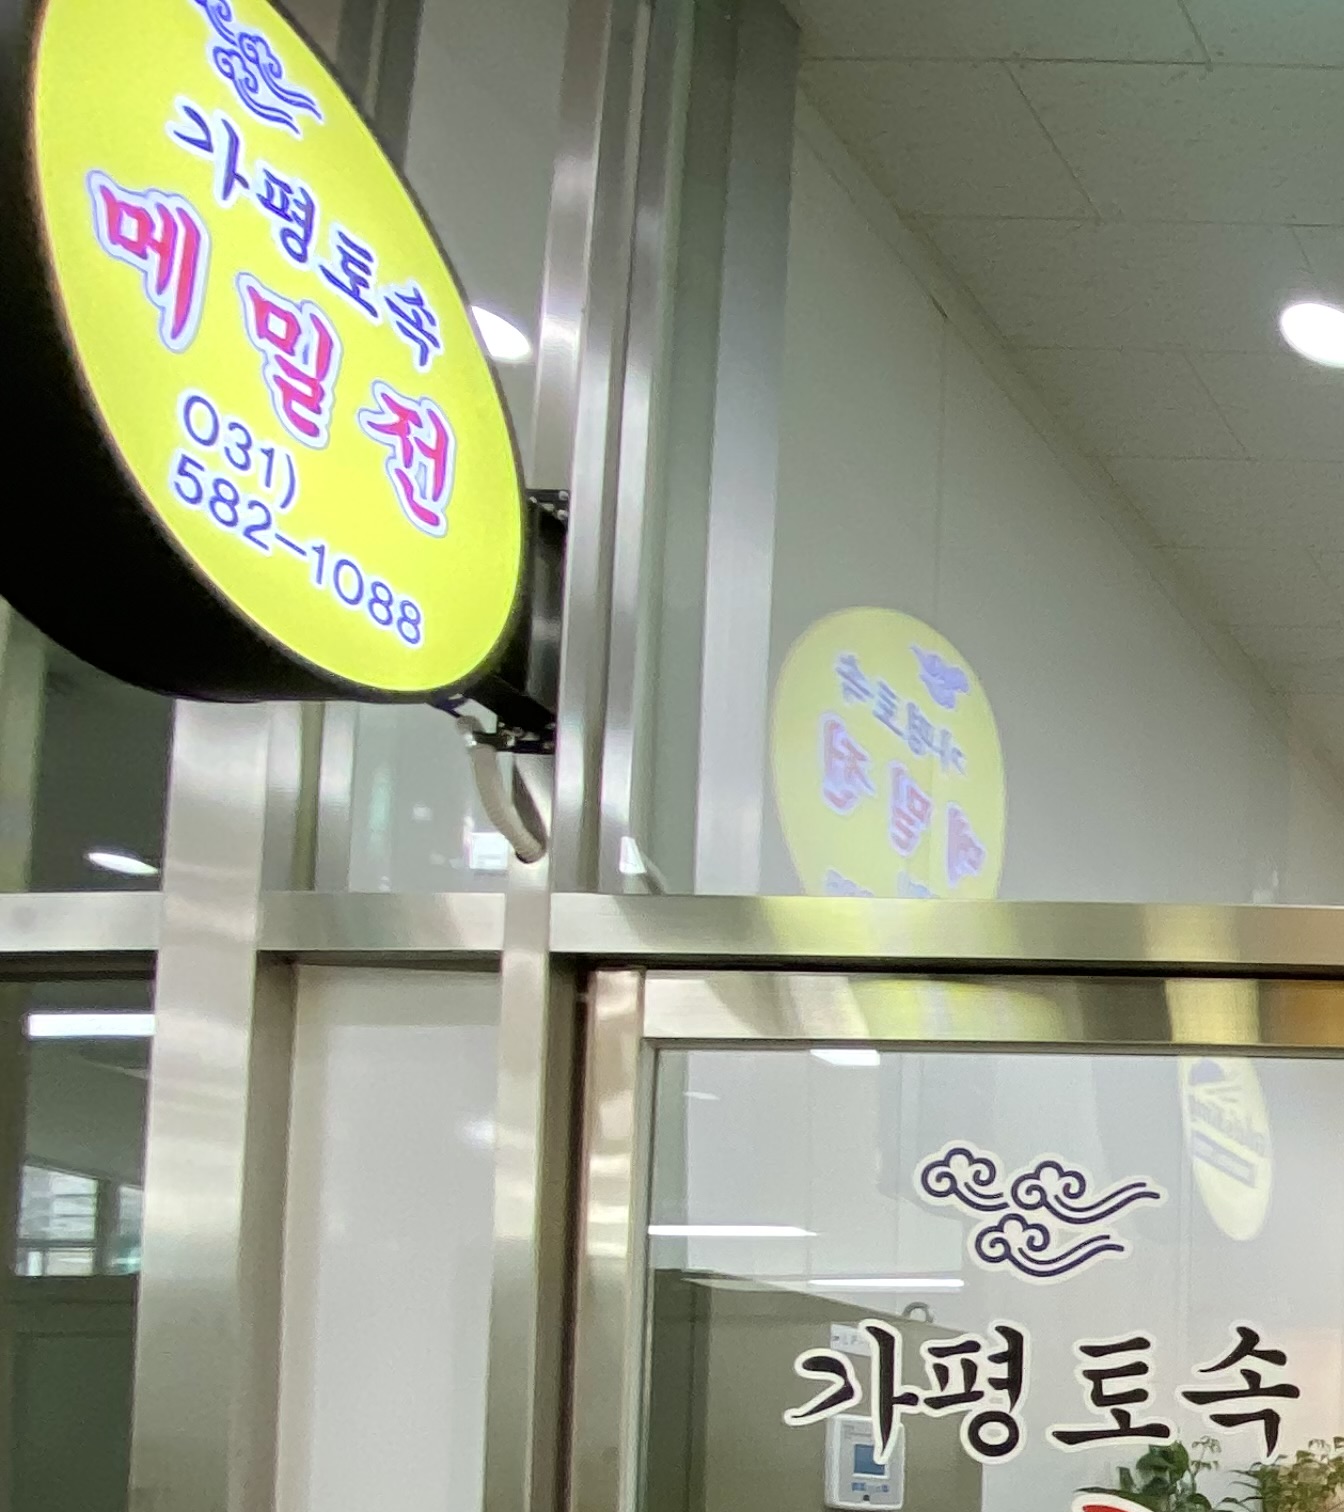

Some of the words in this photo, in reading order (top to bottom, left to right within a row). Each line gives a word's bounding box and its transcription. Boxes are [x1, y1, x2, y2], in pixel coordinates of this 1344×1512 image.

[184, 394, 296, 508] 031)
[173, 456, 423, 646] 582-1088
[785, 1325, 1301, 1458] 가평토속
